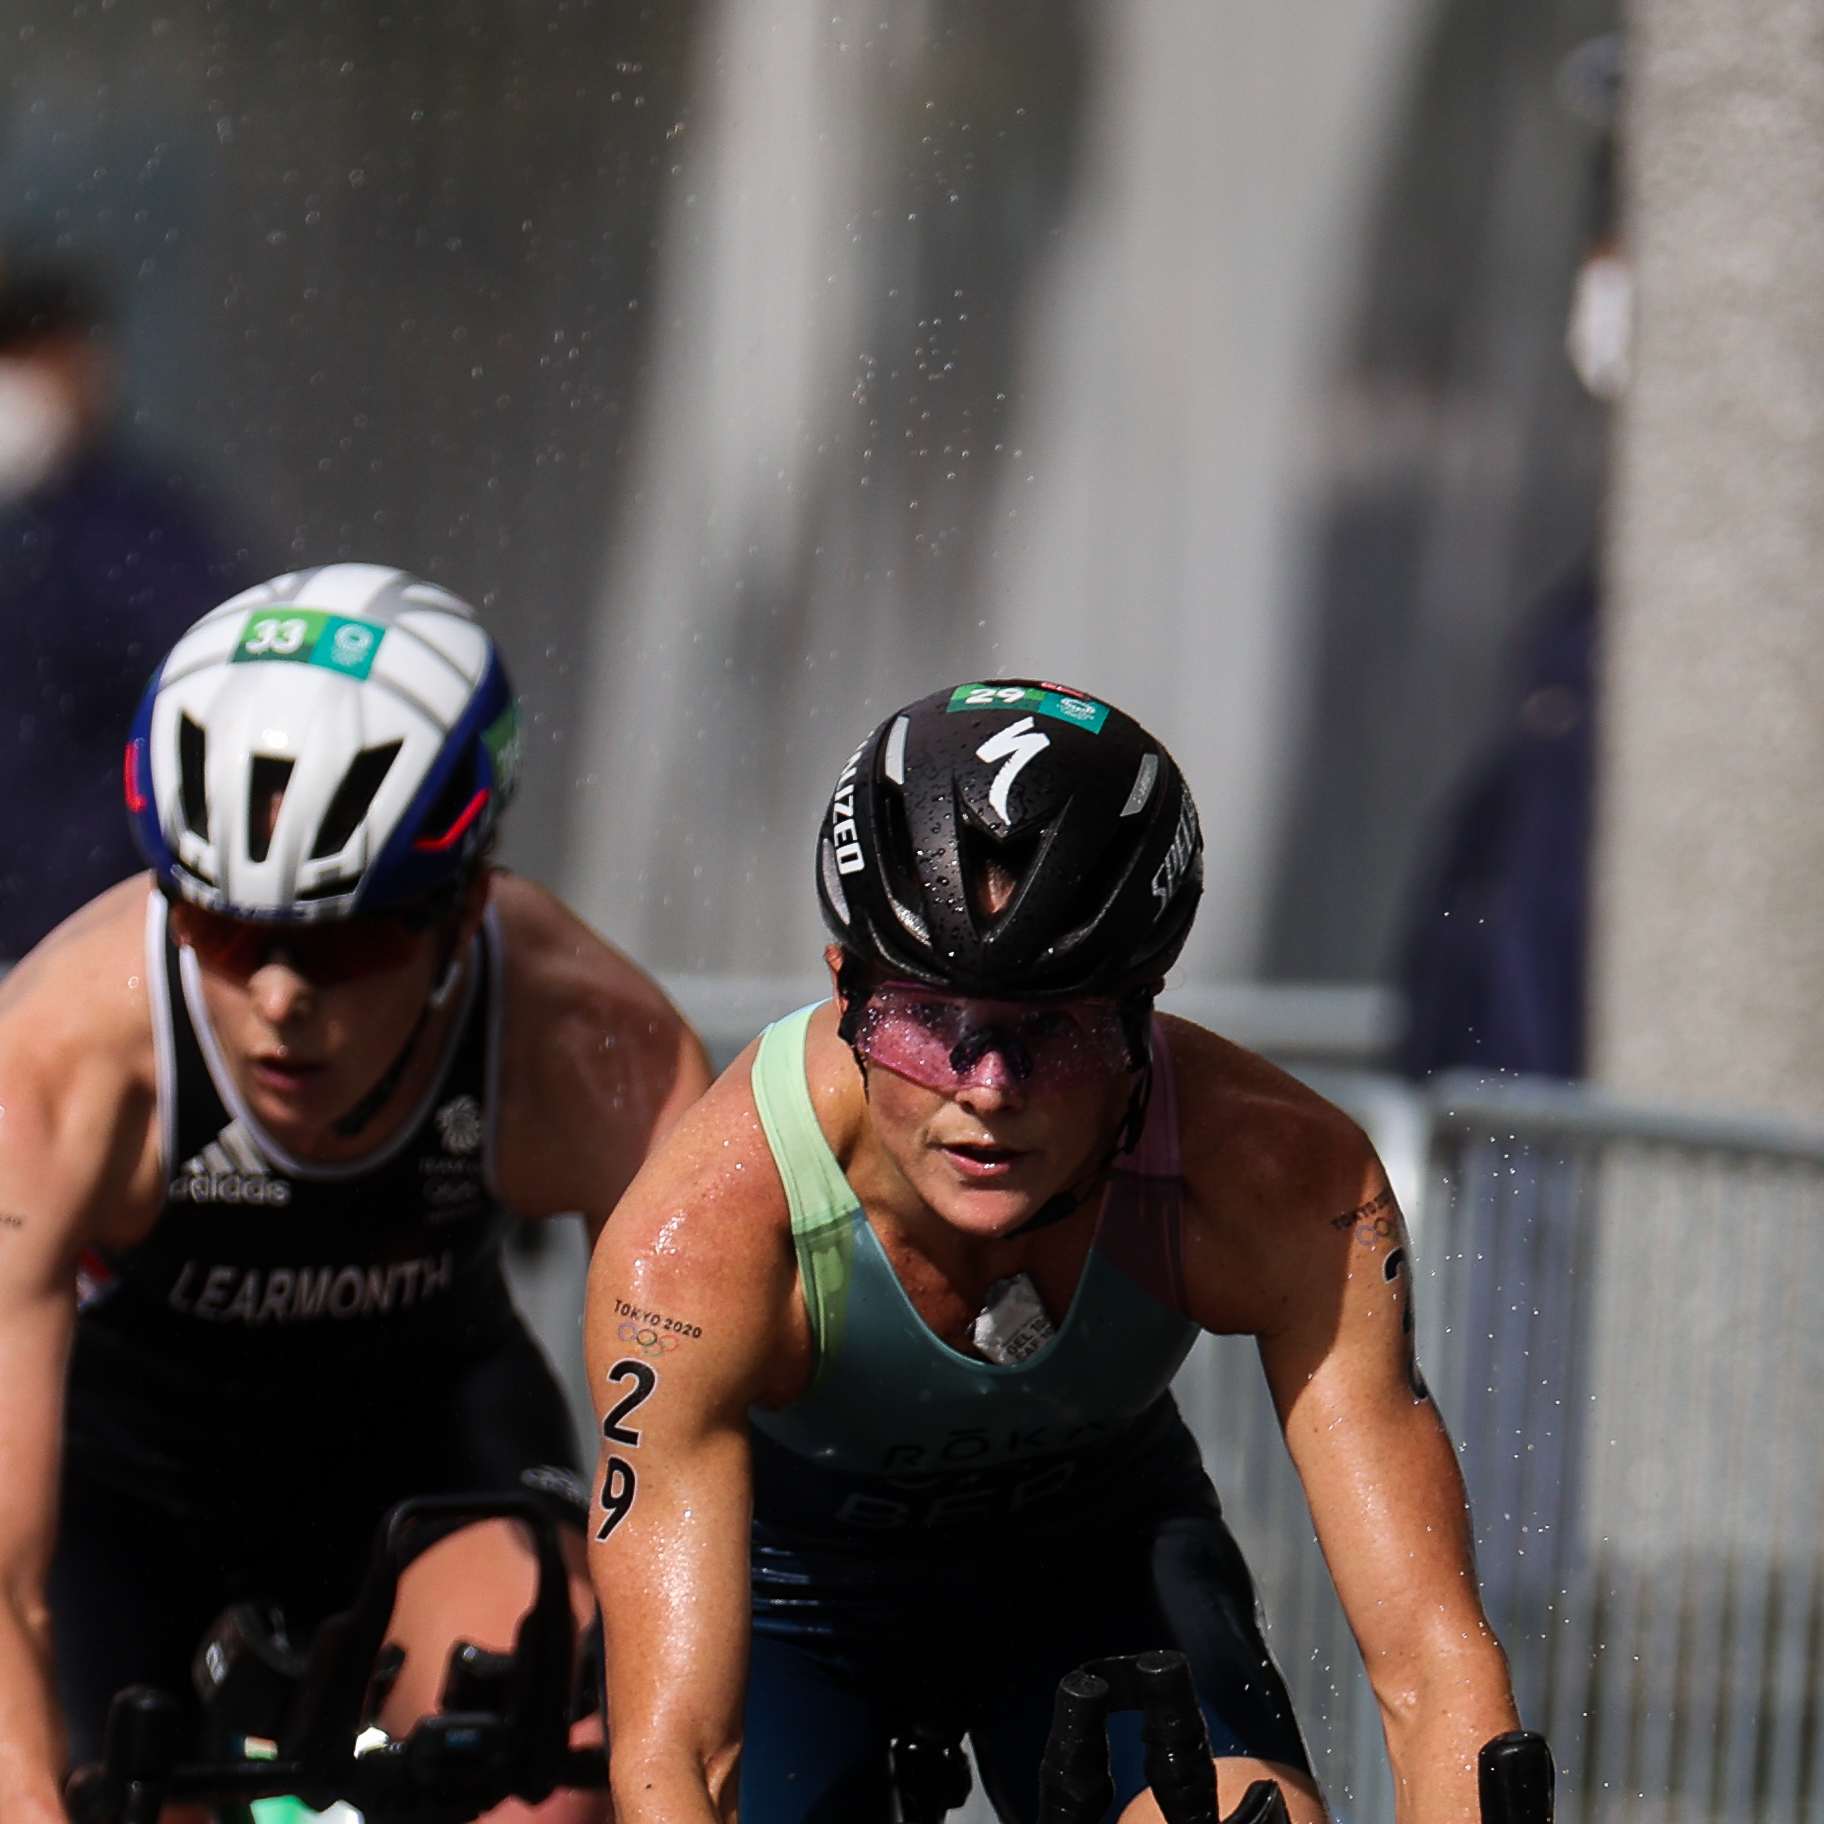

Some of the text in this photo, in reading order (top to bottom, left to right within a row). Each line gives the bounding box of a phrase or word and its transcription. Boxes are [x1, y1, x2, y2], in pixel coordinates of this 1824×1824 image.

[244, 617, 308, 655] 33
[965, 687, 1026, 705] 29
[169, 1173, 293, 1207] adidas
[168, 1251, 455, 1326] LEARMONTH
[613, 1299, 703, 1340] TOKYO 2020
